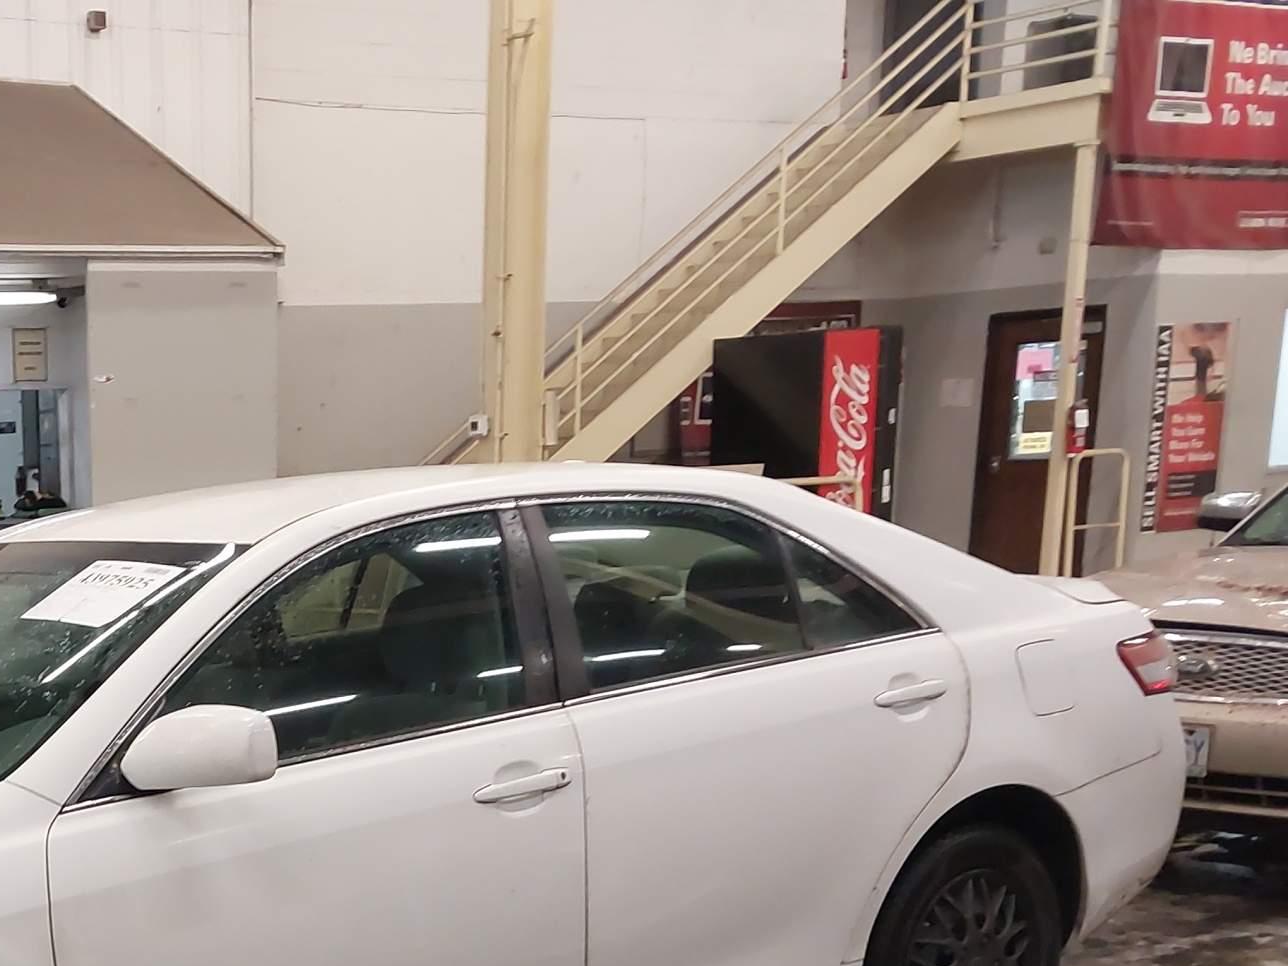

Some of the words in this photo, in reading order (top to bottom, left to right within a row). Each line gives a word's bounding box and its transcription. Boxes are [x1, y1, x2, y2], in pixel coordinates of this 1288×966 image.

[1228, 40, 1254, 64] We
[1224, 72, 1255, 94] The
[1220, 103, 1240, 126] To
[1246, 104, 1275, 126] You
[1158, 330, 1172, 361] IAA
[1152, 366, 1168, 415] WITH
[1146, 422, 1163, 482] SMART
